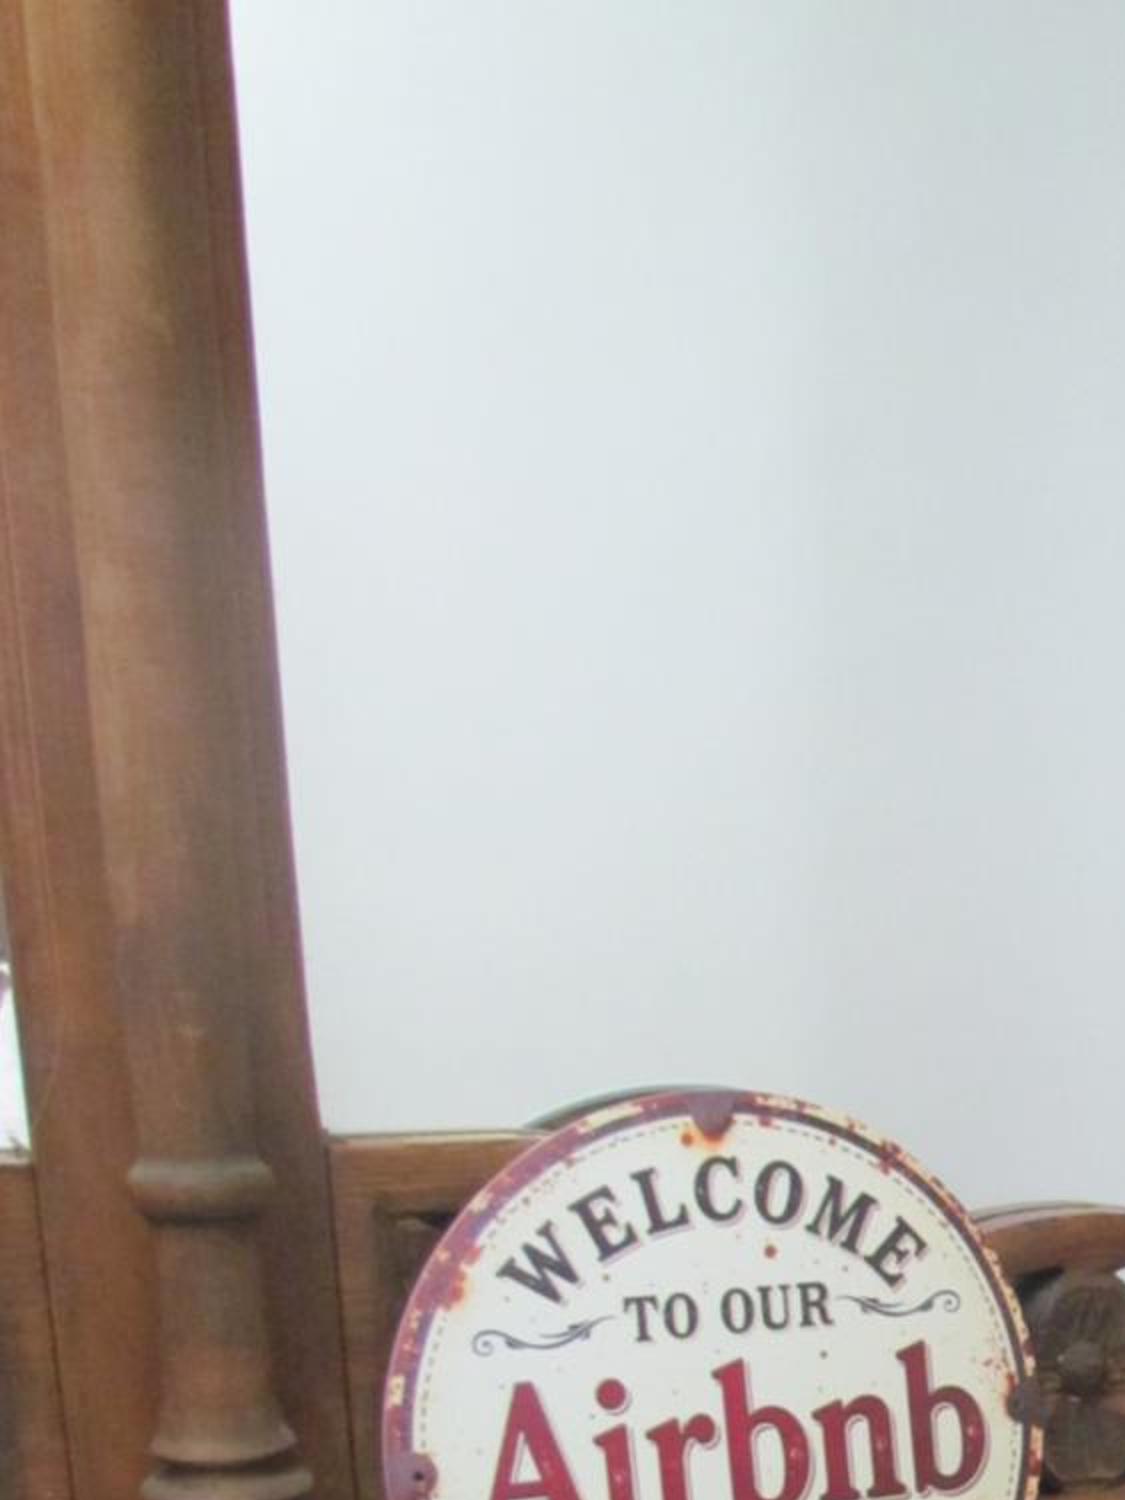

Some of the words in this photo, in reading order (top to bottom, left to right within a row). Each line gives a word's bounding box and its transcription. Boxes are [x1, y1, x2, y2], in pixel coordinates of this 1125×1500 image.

[496, 1155, 929, 1306] WELCOME
[623, 1292, 698, 1343] TO
[720, 1281, 835, 1335] OUR
